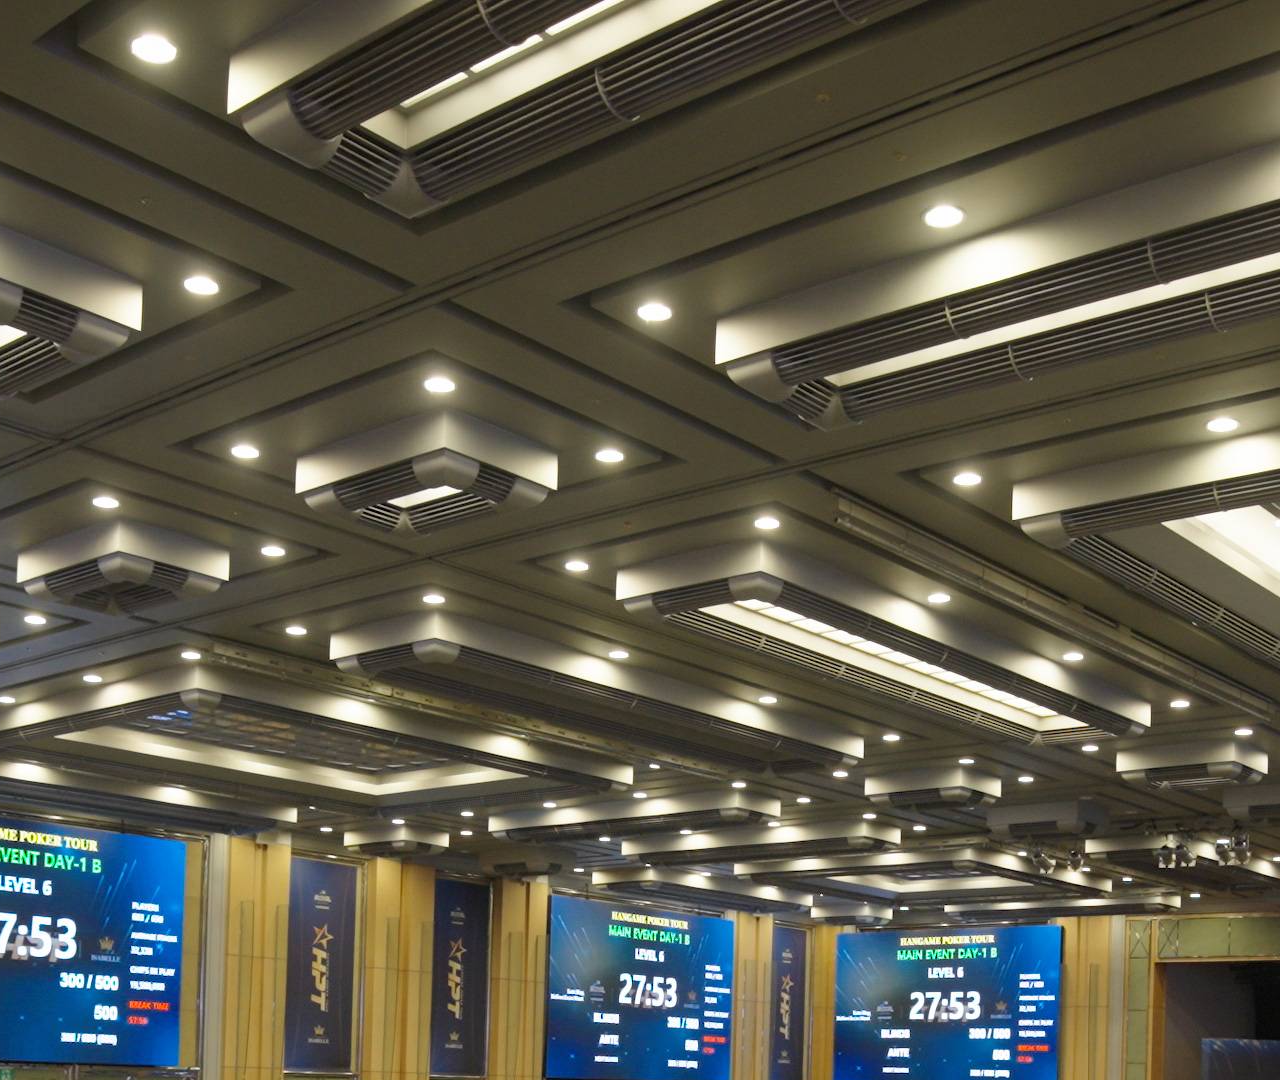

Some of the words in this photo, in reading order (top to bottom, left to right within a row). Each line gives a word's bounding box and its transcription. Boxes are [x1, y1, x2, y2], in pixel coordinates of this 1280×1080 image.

[19, 830, 62, 847] POKER
[64, 836, 98, 852] TOUR
[44, 853, 87, 872] DAY-1
[92, 859, 102, 873] B
[42, 880, 53, 896] 6
[609, 925, 632, 939] MAIN
[633, 928, 659, 941] EVENT
[660, 931, 683, 945] DAY-1
[900, 936, 942, 947] HANGAME
[942, 935, 970, 945] POKER
[635, 948, 658, 962] LEVEL
[897, 950, 923, 961] MAIN
[925, 949, 956, 960] EVENT
[958, 948, 987, 959] DAY-1
[59, 972, 85, 989] 300
[310, 947, 328, 1012] HPT
[927, 967, 955, 979] LEVEL
[447, 959, 462, 1020] HPT
[619, 973, 678, 1008] 27:53
[93, 1004, 118, 1021] 500
[909, 991, 981, 1021] 27:53
